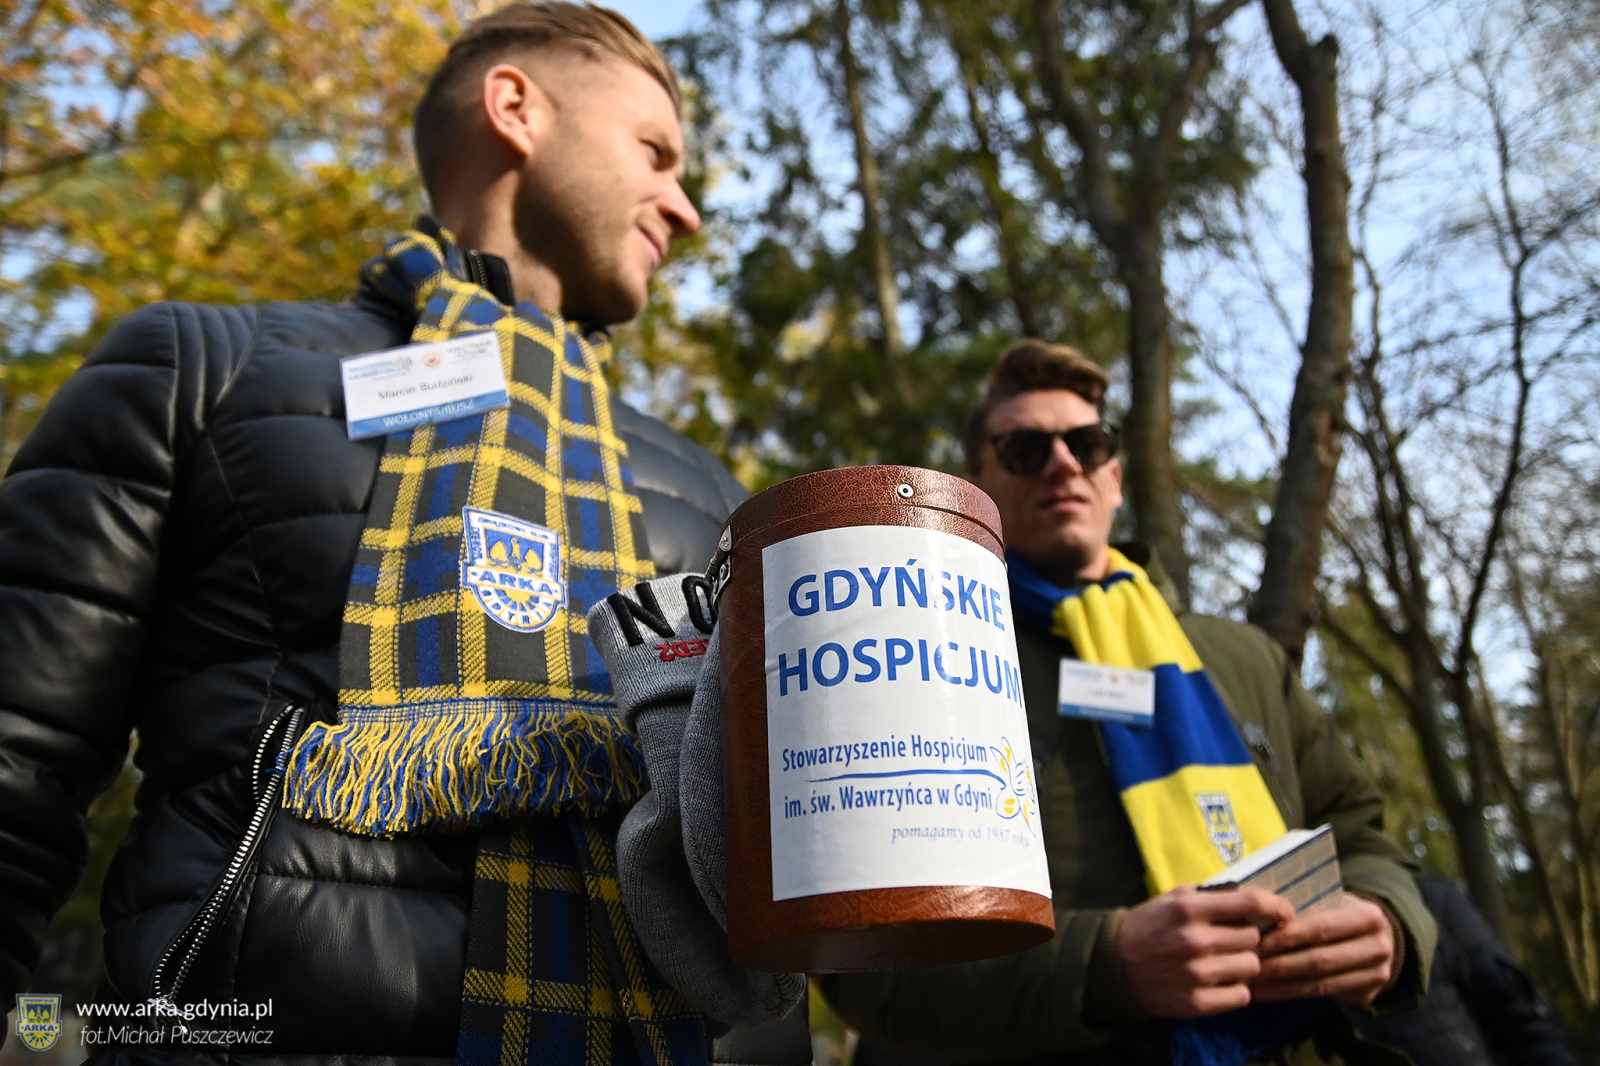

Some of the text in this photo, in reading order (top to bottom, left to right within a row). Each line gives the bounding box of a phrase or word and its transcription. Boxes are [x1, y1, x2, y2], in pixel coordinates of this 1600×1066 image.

[378, 385, 416, 400] Marcin
[383, 399, 475, 427] WOLONTARIUSZ
[479, 570, 553, 595] ARKA
[788, 558, 1006, 631] GDYŃSKIE
[778, 638, 1023, 708] HOSPICJUM
[782, 735, 988, 772] Stowarzyszenie Hospicjum
[784, 781, 993, 819] im. św. Wawrzyńca w Gdyni
[891, 827, 964, 844] pomagamy
[967, 824, 984, 839] od
